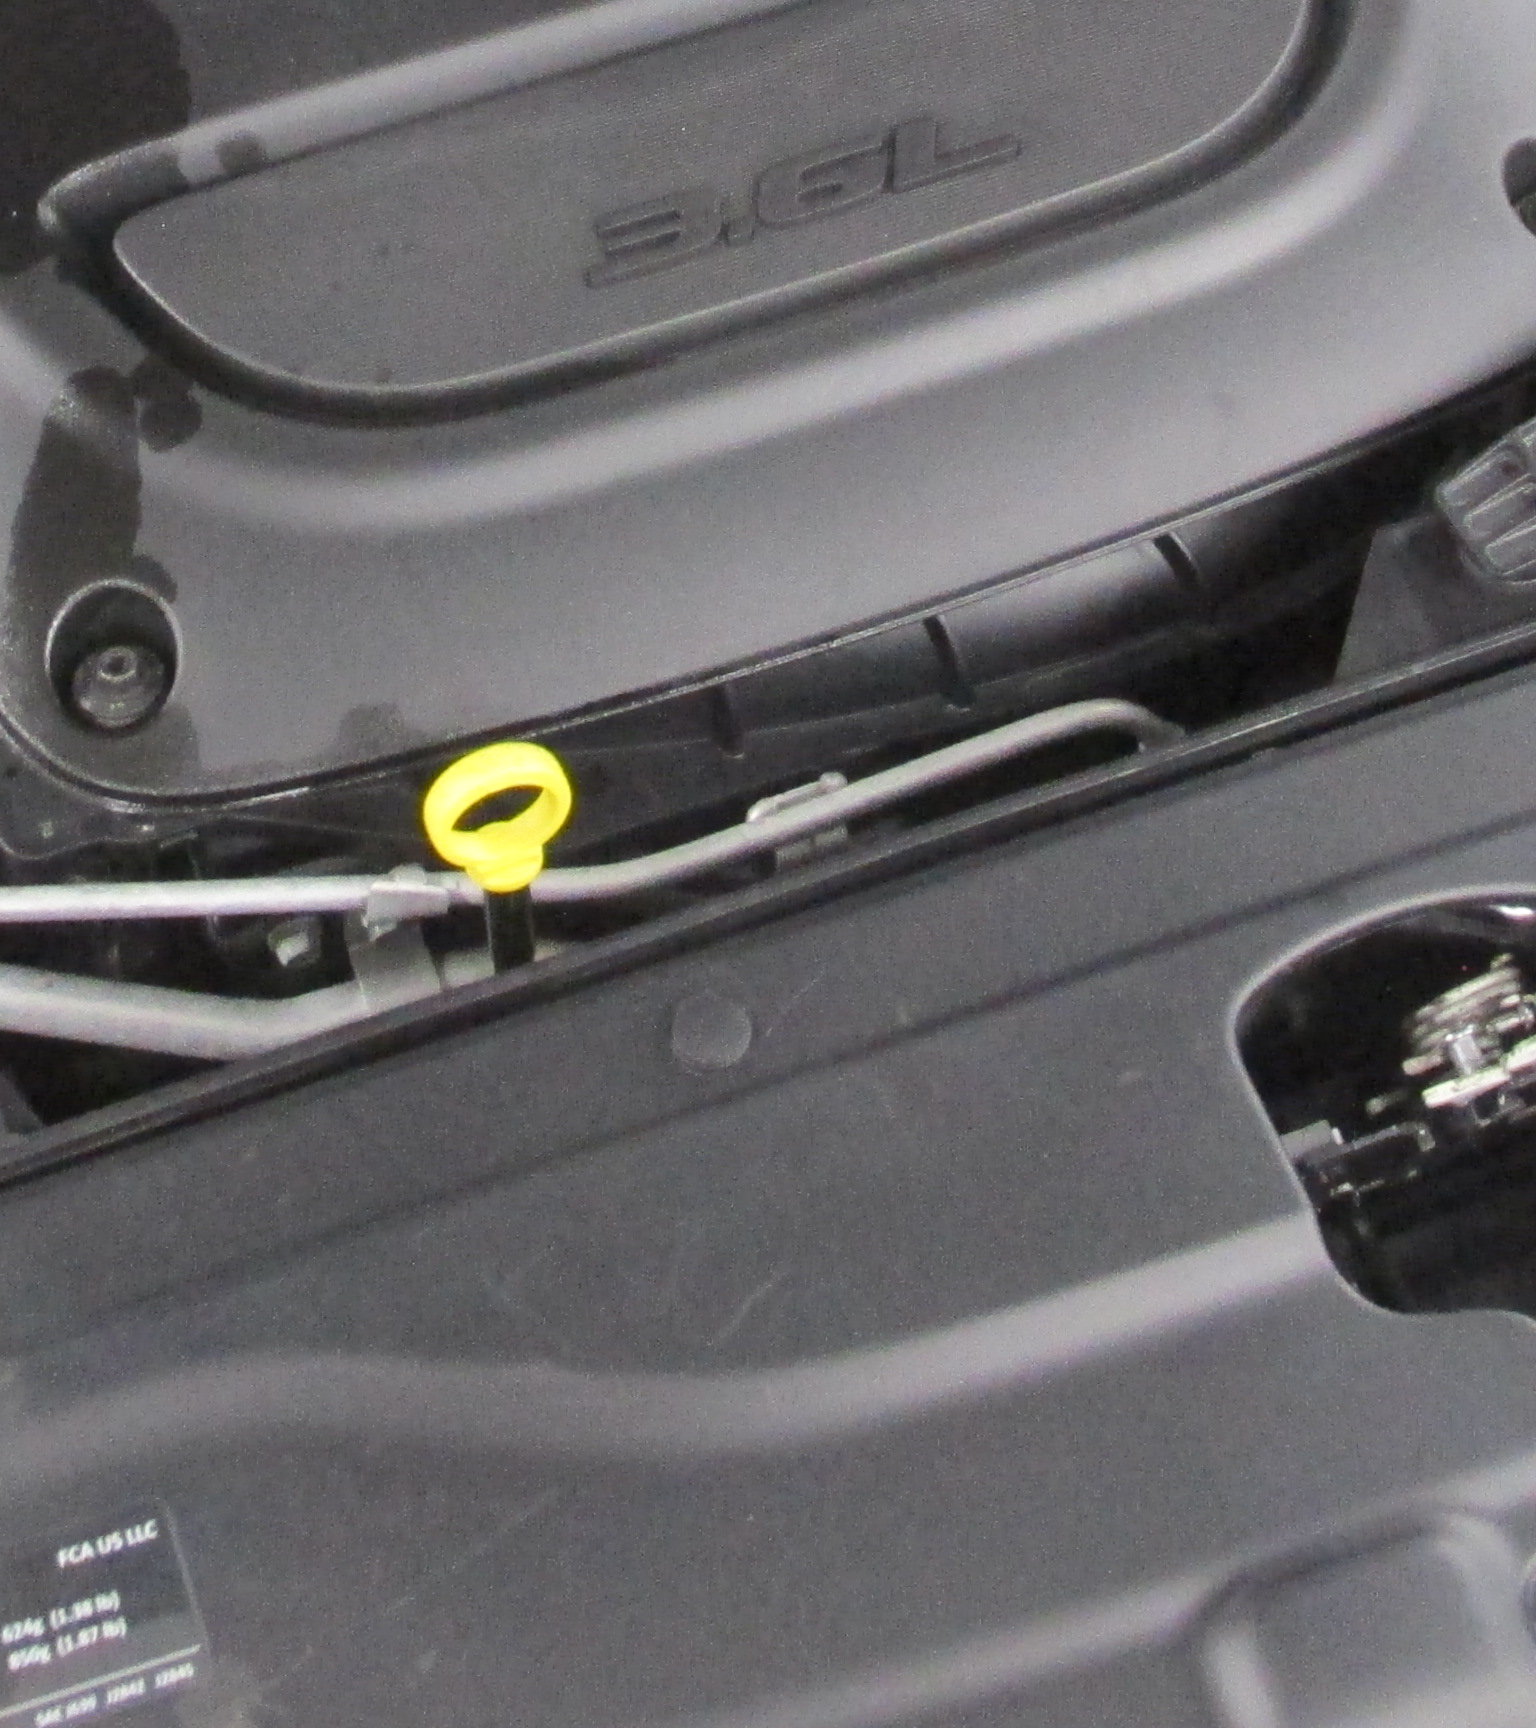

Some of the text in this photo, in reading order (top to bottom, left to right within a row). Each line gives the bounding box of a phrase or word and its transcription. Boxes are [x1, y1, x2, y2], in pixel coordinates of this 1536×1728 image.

[57, 1519, 159, 1568] FCA US LLC
